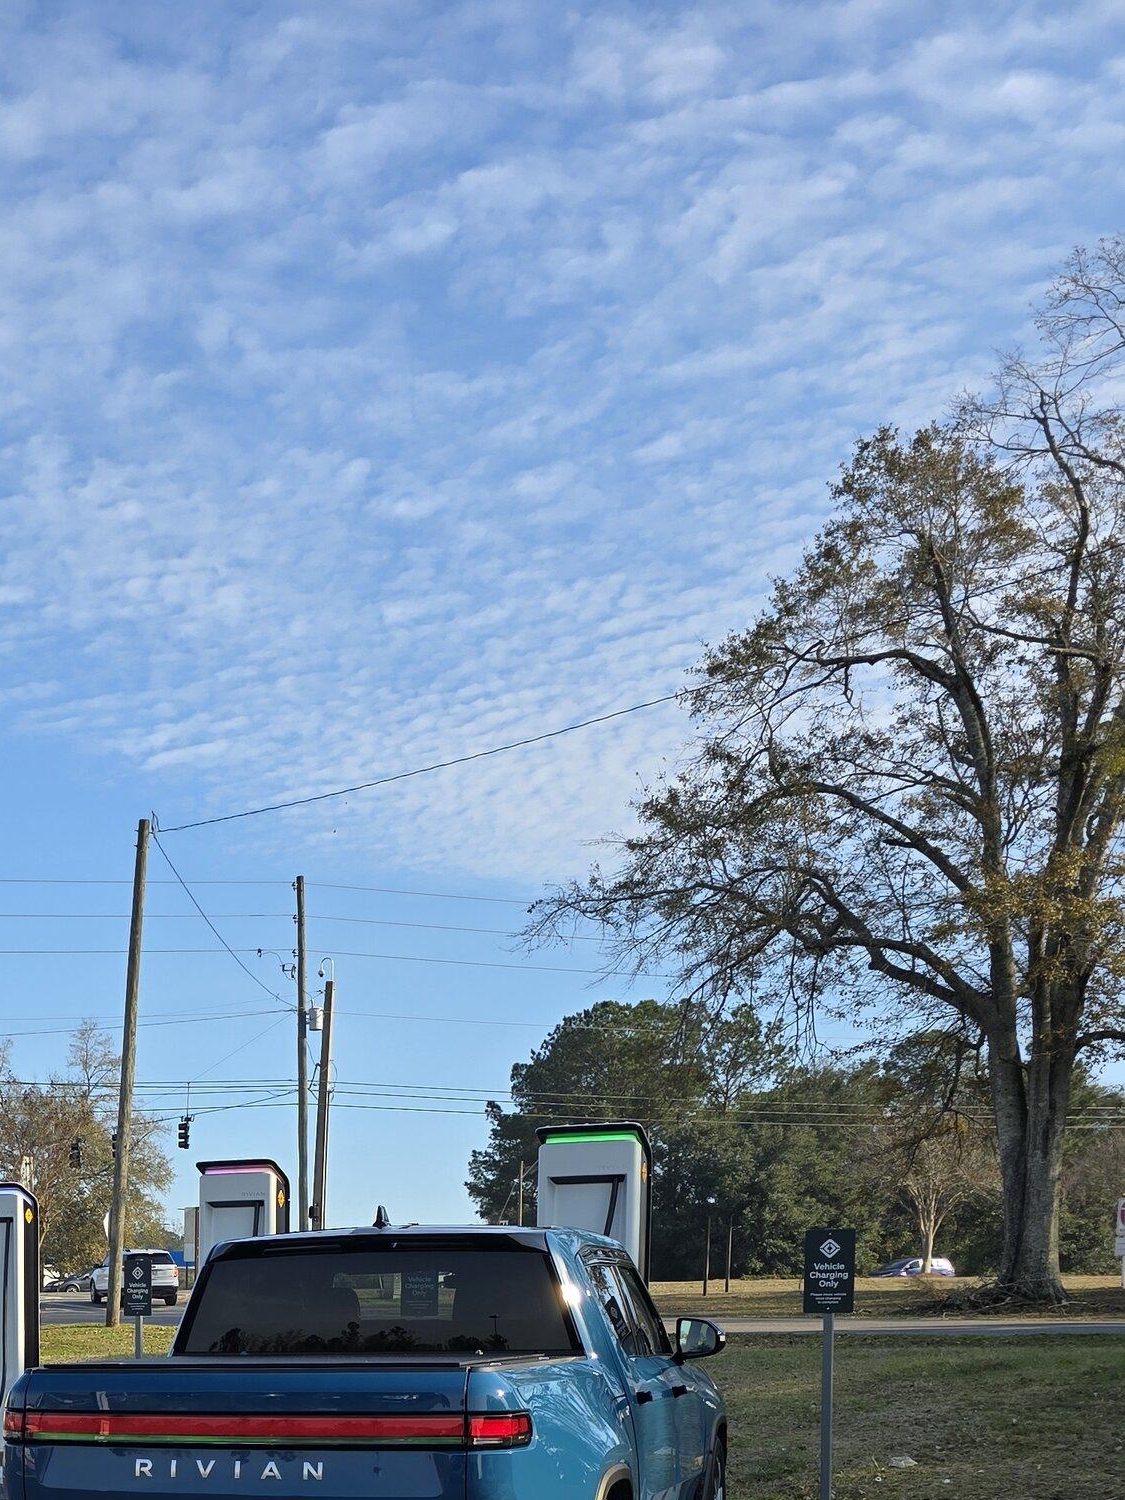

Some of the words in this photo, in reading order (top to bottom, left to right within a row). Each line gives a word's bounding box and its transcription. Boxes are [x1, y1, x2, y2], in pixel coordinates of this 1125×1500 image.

[810, 1271, 848, 1280] Charging
[819, 1280, 838, 1288] Only
[134, 1458, 323, 1480] RIVIAN
